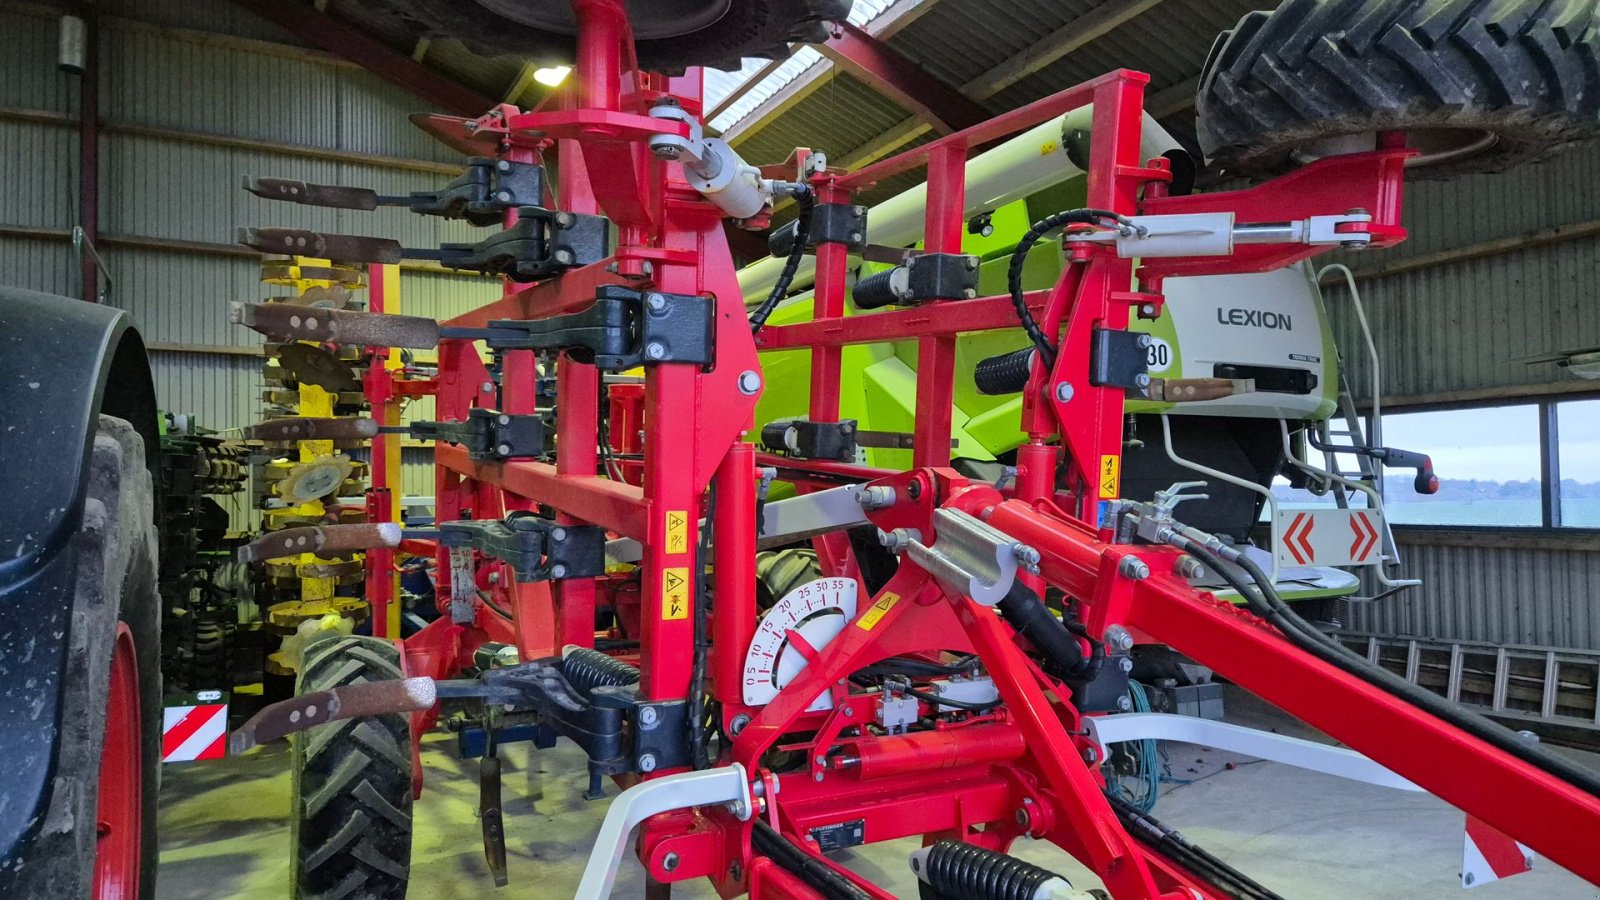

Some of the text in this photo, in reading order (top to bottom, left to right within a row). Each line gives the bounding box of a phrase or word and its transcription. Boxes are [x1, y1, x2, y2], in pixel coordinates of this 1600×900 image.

[1217, 307, 1292, 331] LEXION
[1147, 344, 1168, 366] 30
[746, 678, 755, 686] 0
[751, 644, 762, 658] 10
[761, 620, 773, 634] 15
[778, 599, 791, 614] 20
[798, 587, 811, 599] 25
[816, 581, 828, 592] 30
[832, 580, 844, 590] 35
